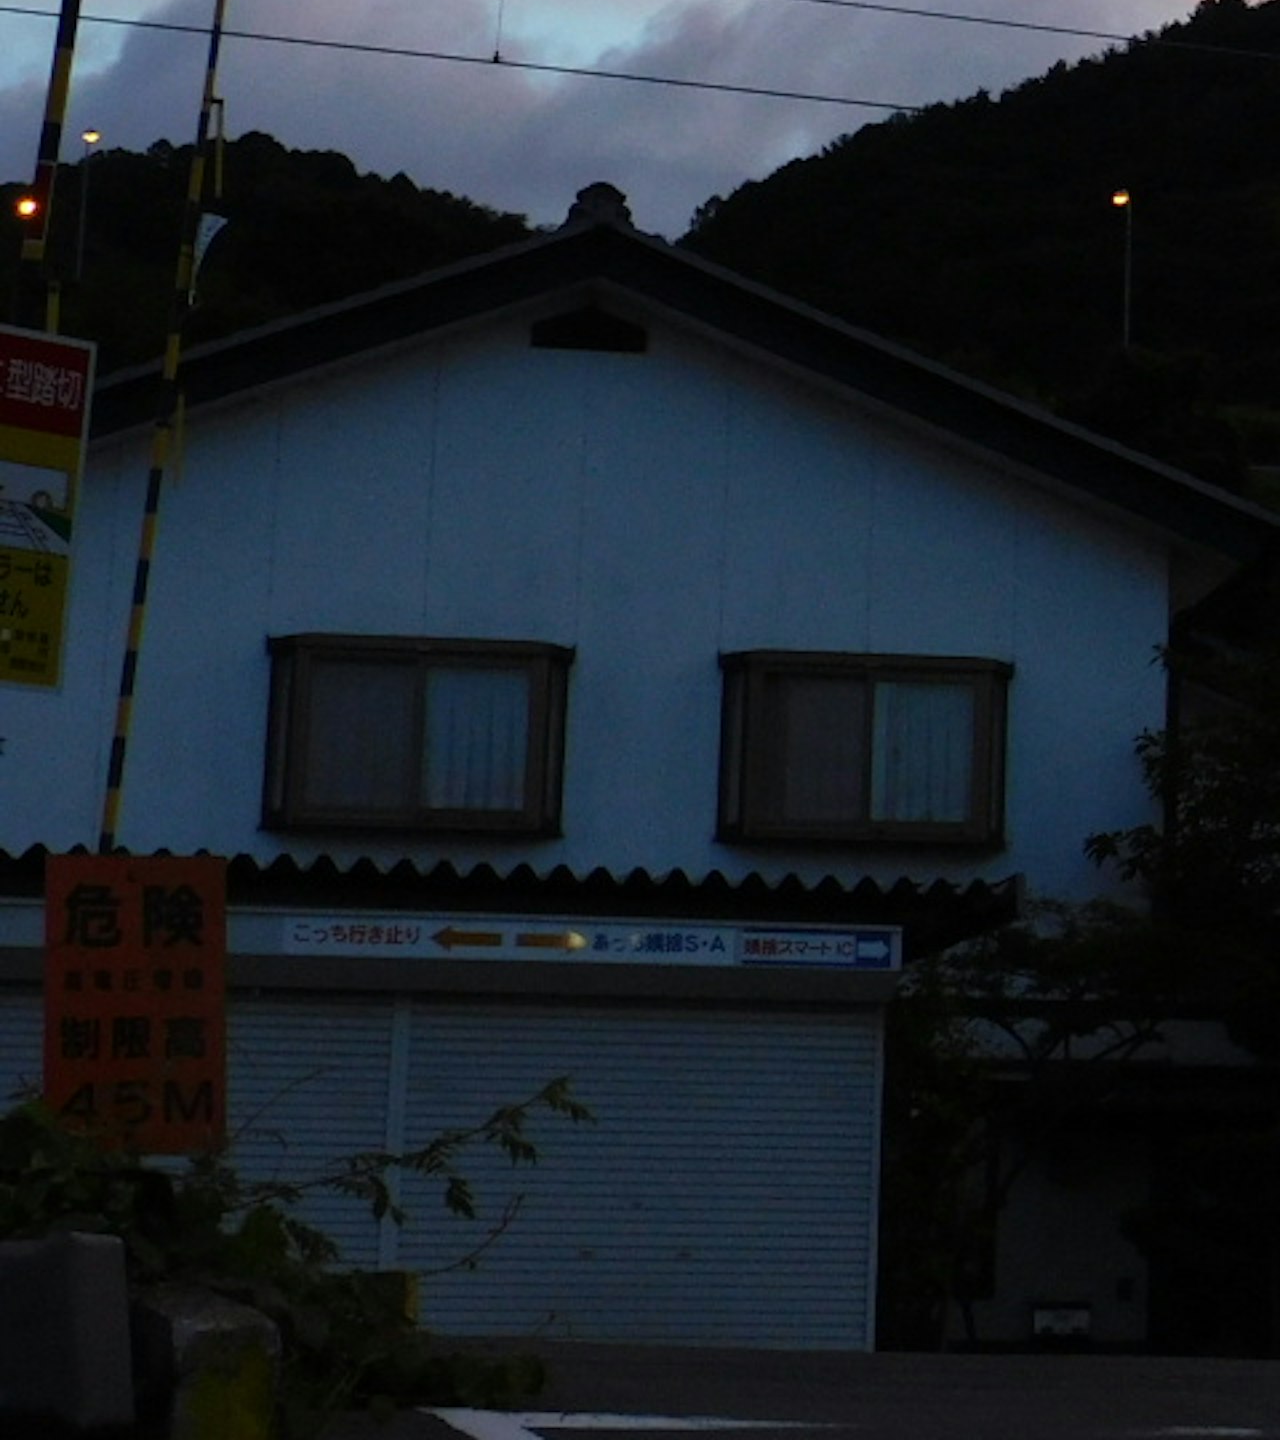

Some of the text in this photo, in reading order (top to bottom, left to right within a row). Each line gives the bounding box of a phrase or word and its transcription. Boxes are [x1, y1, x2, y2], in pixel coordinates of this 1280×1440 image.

[0, 358, 84, 411] 型踏切
[64, 882, 204, 949] 危険
[61, 1015, 205, 1059] 制限高
